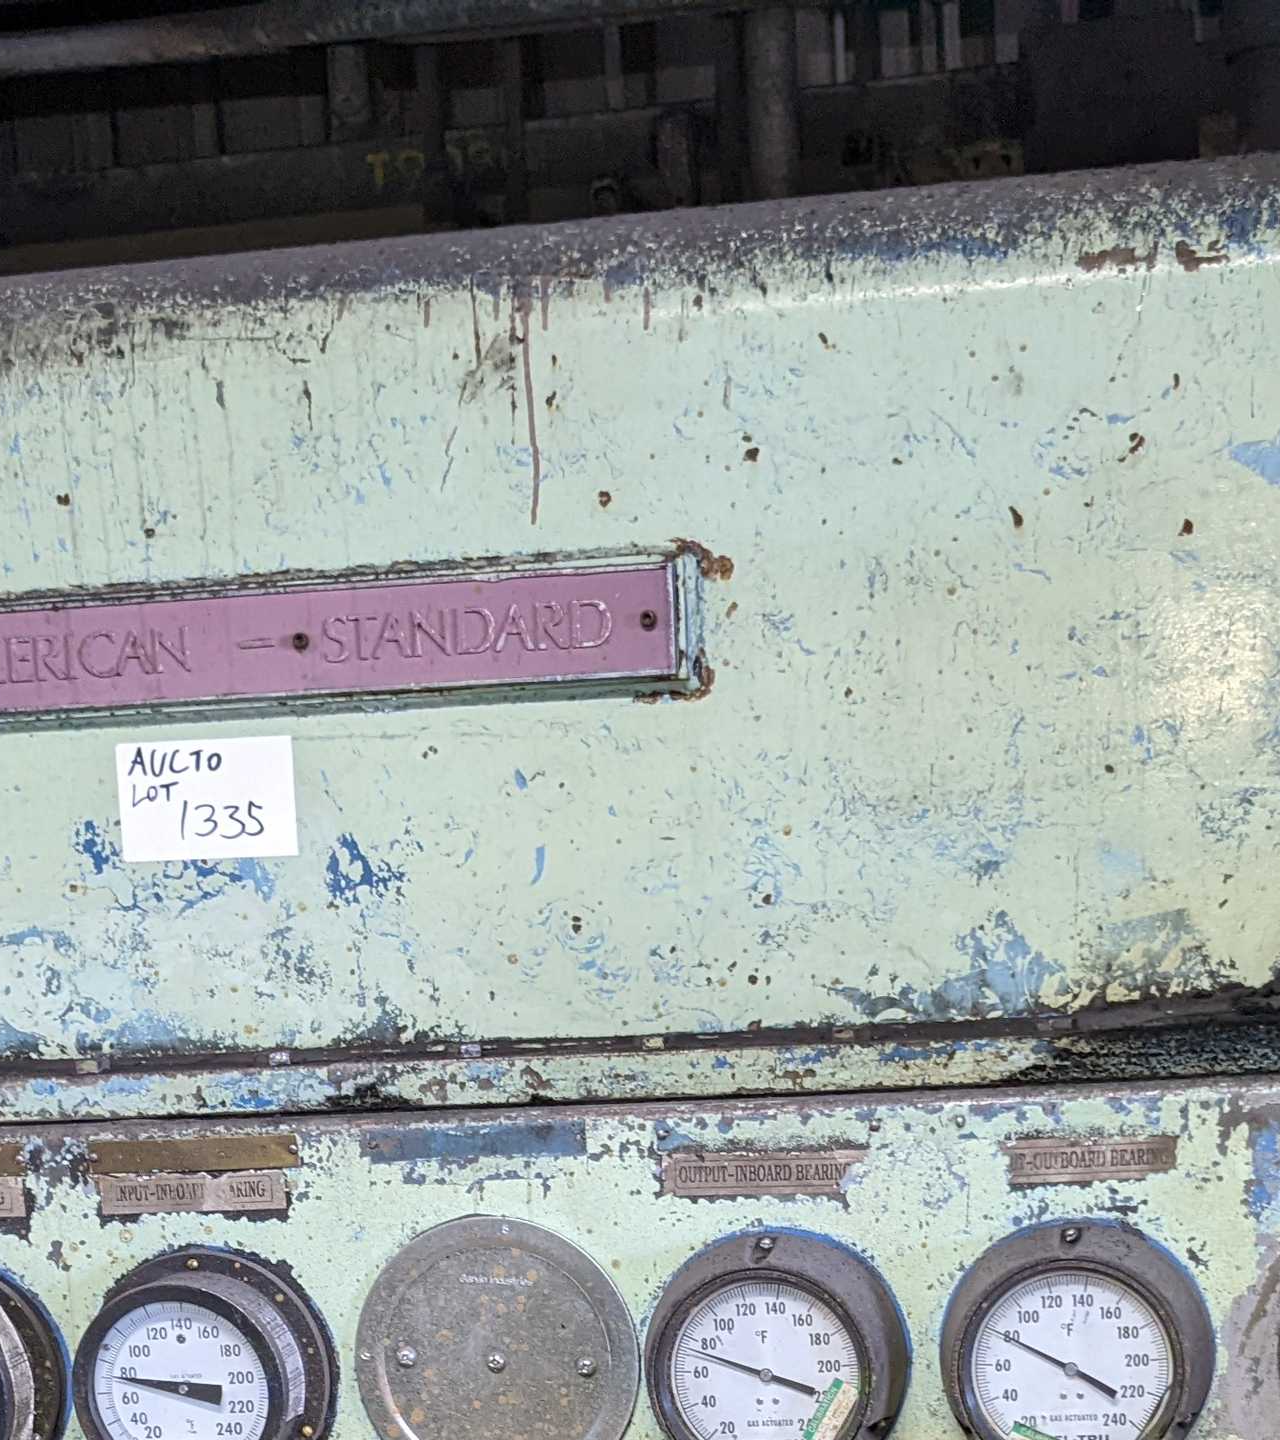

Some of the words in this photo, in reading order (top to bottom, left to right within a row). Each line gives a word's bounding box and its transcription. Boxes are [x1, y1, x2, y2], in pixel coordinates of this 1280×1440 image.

[322, 599, 613, 664] STANDARD
[127, 746, 222, 777] AUCTO
[132, 781, 179, 808] LOT
[180, 800, 265, 840] 1335
[678, 1164, 792, 1183] OUTPUT-INBOARD
[1040, 1295, 1063, 1309] 120
[1072, 1294, 1094, 1307] 140
[736, 1303, 756, 1316] 120
[765, 1302, 786, 1314] 140
[1100, 1307, 1122, 1319] 160
[792, 1314, 813, 1327] 160
[1017, 1311, 1039, 1323] 100
[171, 1318, 192, 1330] 140
[714, 1319, 735, 1331] 100
[147, 1327, 167, 1340] 120
[198, 1326, 219, 1338] 160
[1003, 1330, 1020, 1343] 80
[1117, 1326, 1139, 1339] 180
[701, 1337, 717, 1350] 80
[809, 1333, 830, 1346] 180
[129, 1345, 150, 1357] 100
[220, 1344, 241, 1357] 180
[817, 1360, 841, 1373] 200
[995, 1359, 1011, 1371] 60
[1125, 1354, 1149, 1367] 200
[228, 1371, 254, 1384] 200
[693, 1366, 709, 1379] 60
[122, 1392, 139, 1404] 60
[1002, 1389, 1018, 1401] 40
[1120, 1385, 1145, 1398] 220
[228, 1400, 254, 1413] 220
[701, 1395, 716, 1408] 40
[130, 1412, 148, 1425] 40
[1021, 1416, 1036, 1428] 20
[1102, 1413, 1127, 1426] 240
[144, 1426, 162, 1438] 20
[216, 1422, 242, 1435] 240
[720, 1421, 735, 1434] 20
